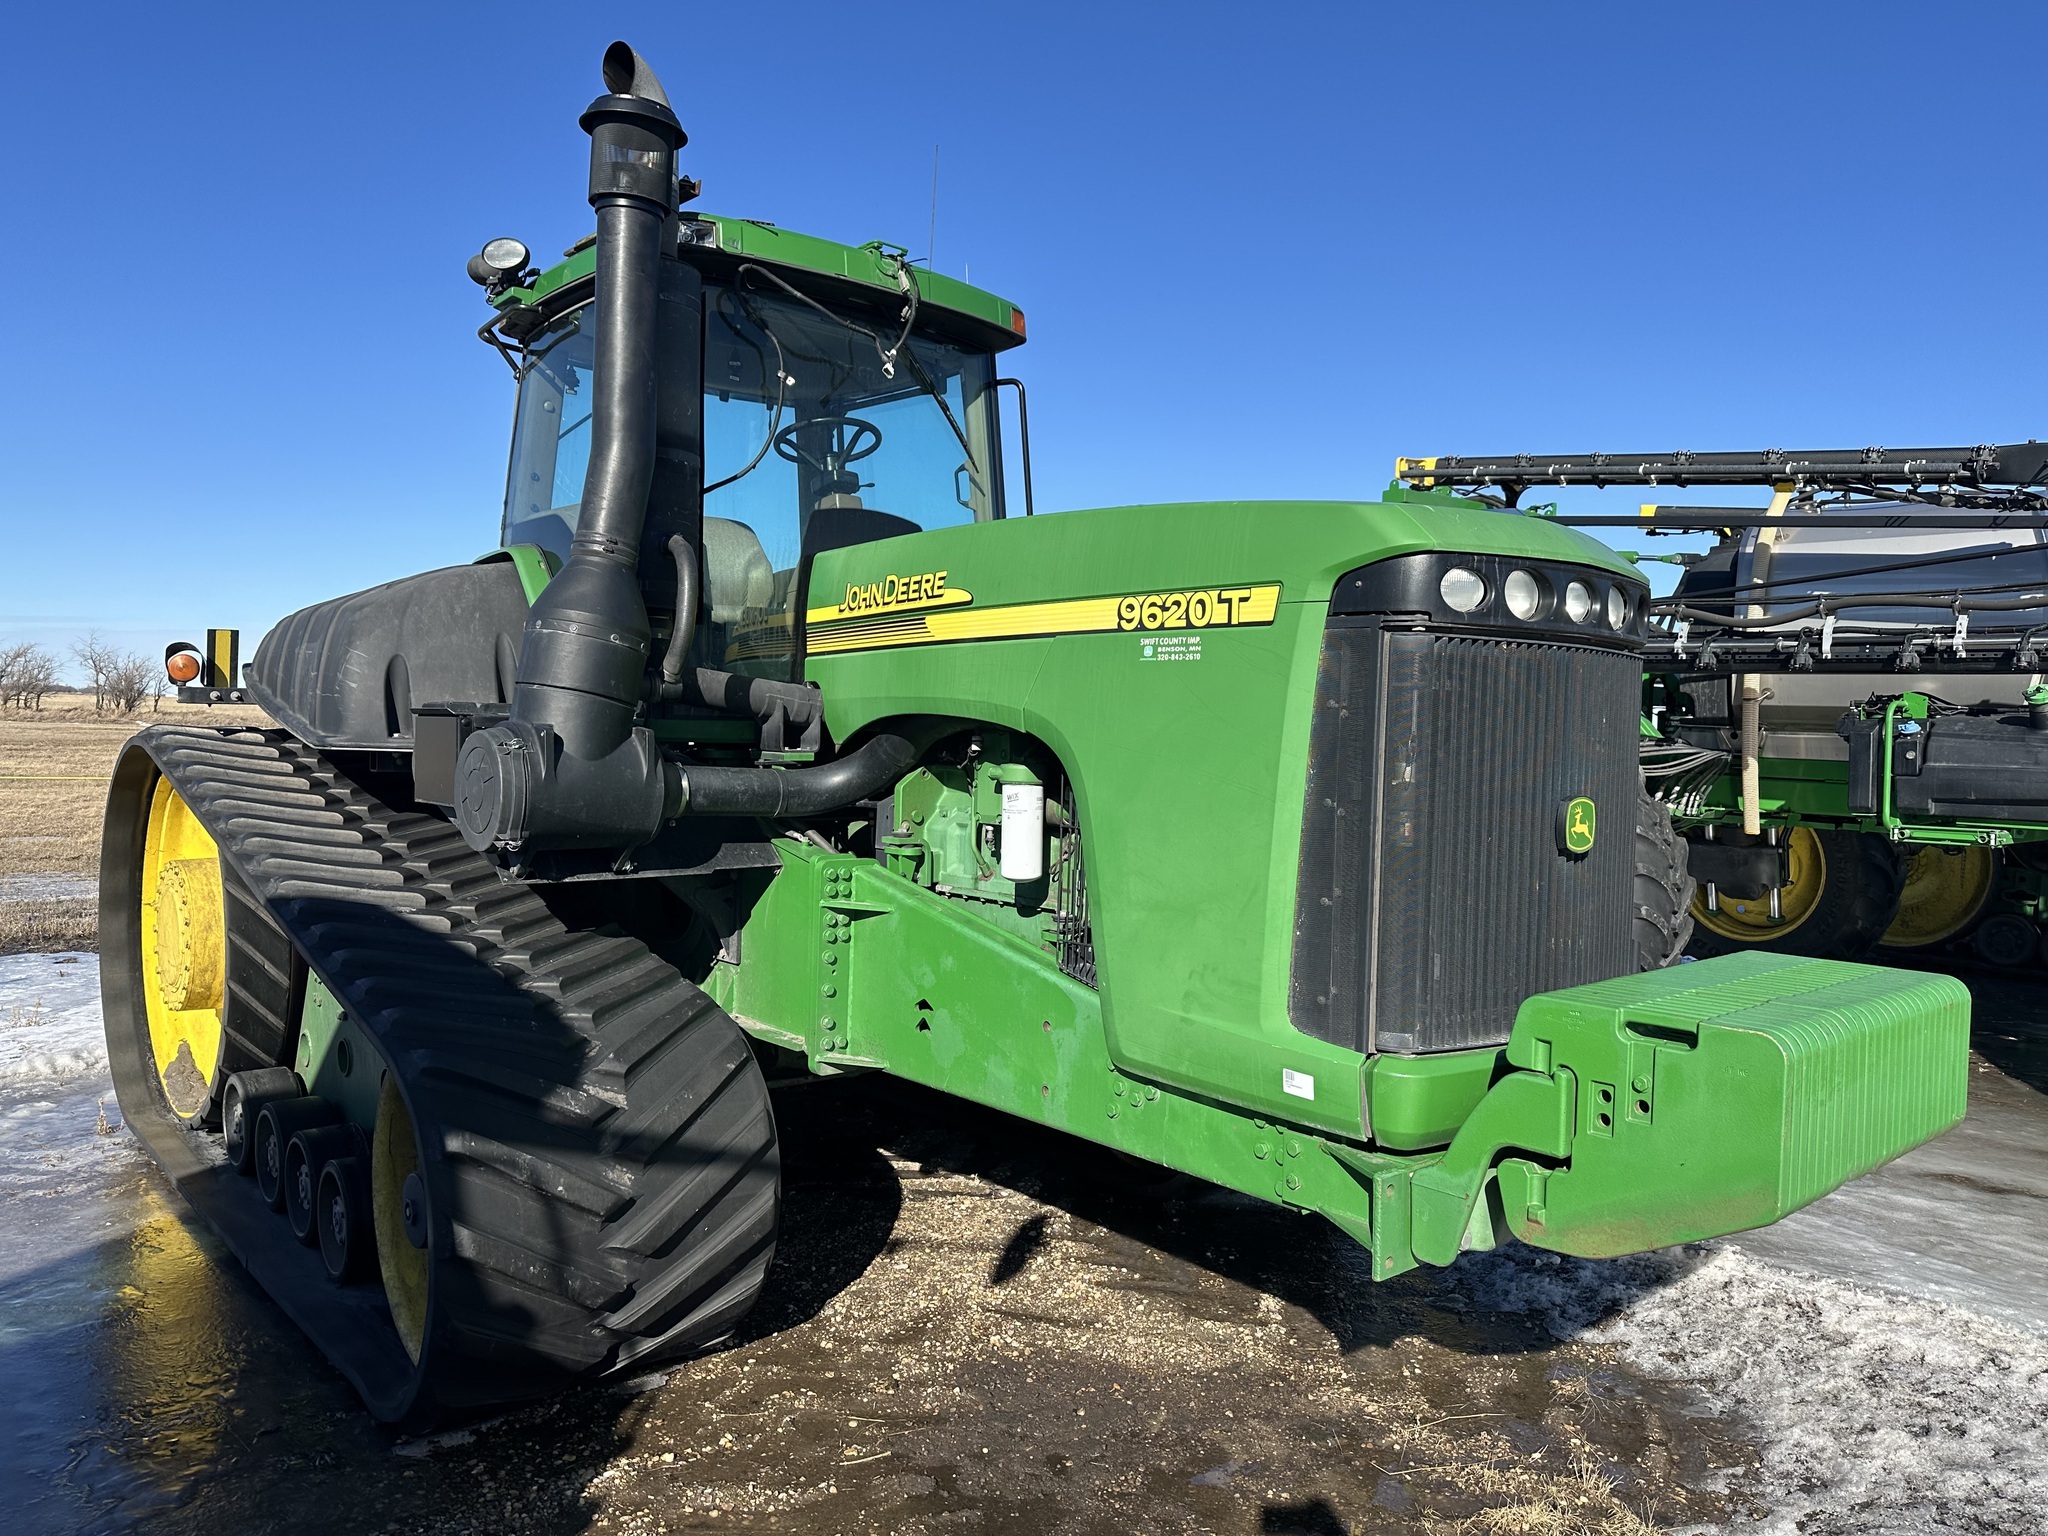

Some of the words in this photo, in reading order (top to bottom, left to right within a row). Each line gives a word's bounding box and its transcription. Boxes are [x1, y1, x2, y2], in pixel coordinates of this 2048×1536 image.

[839, 582, 883, 612] JOHN
[882, 570, 948, 606] DEERE
[1118, 588, 1252, 631] 9620T
[1160, 637, 1187, 645] COUNTY
[1187, 636, 1202, 644] IMP.
[1157, 653, 1201, 661] 320-843-2610
[1007, 792, 1019, 801] WIX
